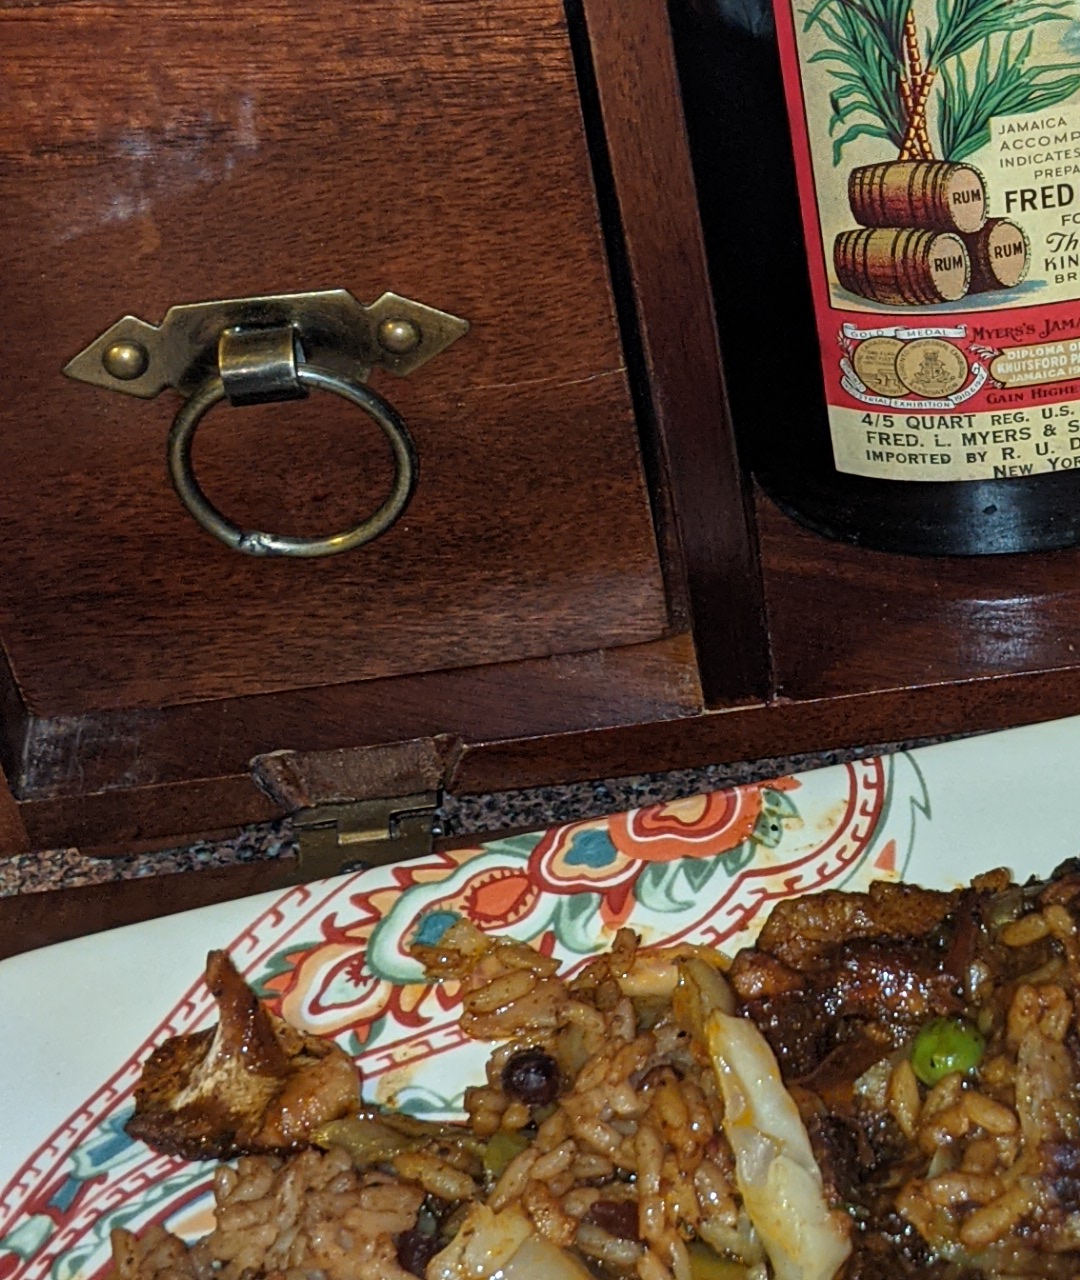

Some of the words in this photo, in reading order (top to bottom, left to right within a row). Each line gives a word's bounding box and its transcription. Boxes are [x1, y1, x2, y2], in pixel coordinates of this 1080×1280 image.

[998, 117, 1067, 135] JAMAICA
[1000, 147, 1080, 168] INDICATES
[952, 189, 982, 205] RUM
[1005, 183, 1074, 213] FRED
[994, 241, 1022, 259] RUM
[934, 255, 963, 272] RUM
[851, 330, 884, 338] GOLD
[1007, 344, 1065, 360] DIPLOMA
[997, 354, 1067, 374] KNUTSFORD
[1008, 368, 1066, 383] JAMAICA
[893, 400, 950, 408] EXHIBITION
[986, 392, 1024, 405] GAIN
[861, 412, 895, 428] 4/5
[905, 414, 976, 430] QUART
[991, 411, 1030, 426] REG.
[1041, 405, 1075, 419] U.S.
[866, 430, 924, 448] FRED.
[962, 427, 1031, 447] MYERS
[1043, 424, 1057, 437] &
[866, 449, 951, 465] IMPORTED
[966, 451, 988, 464] BY
[1001, 447, 1021, 461] R.
[1035, 442, 1056, 456] U.
